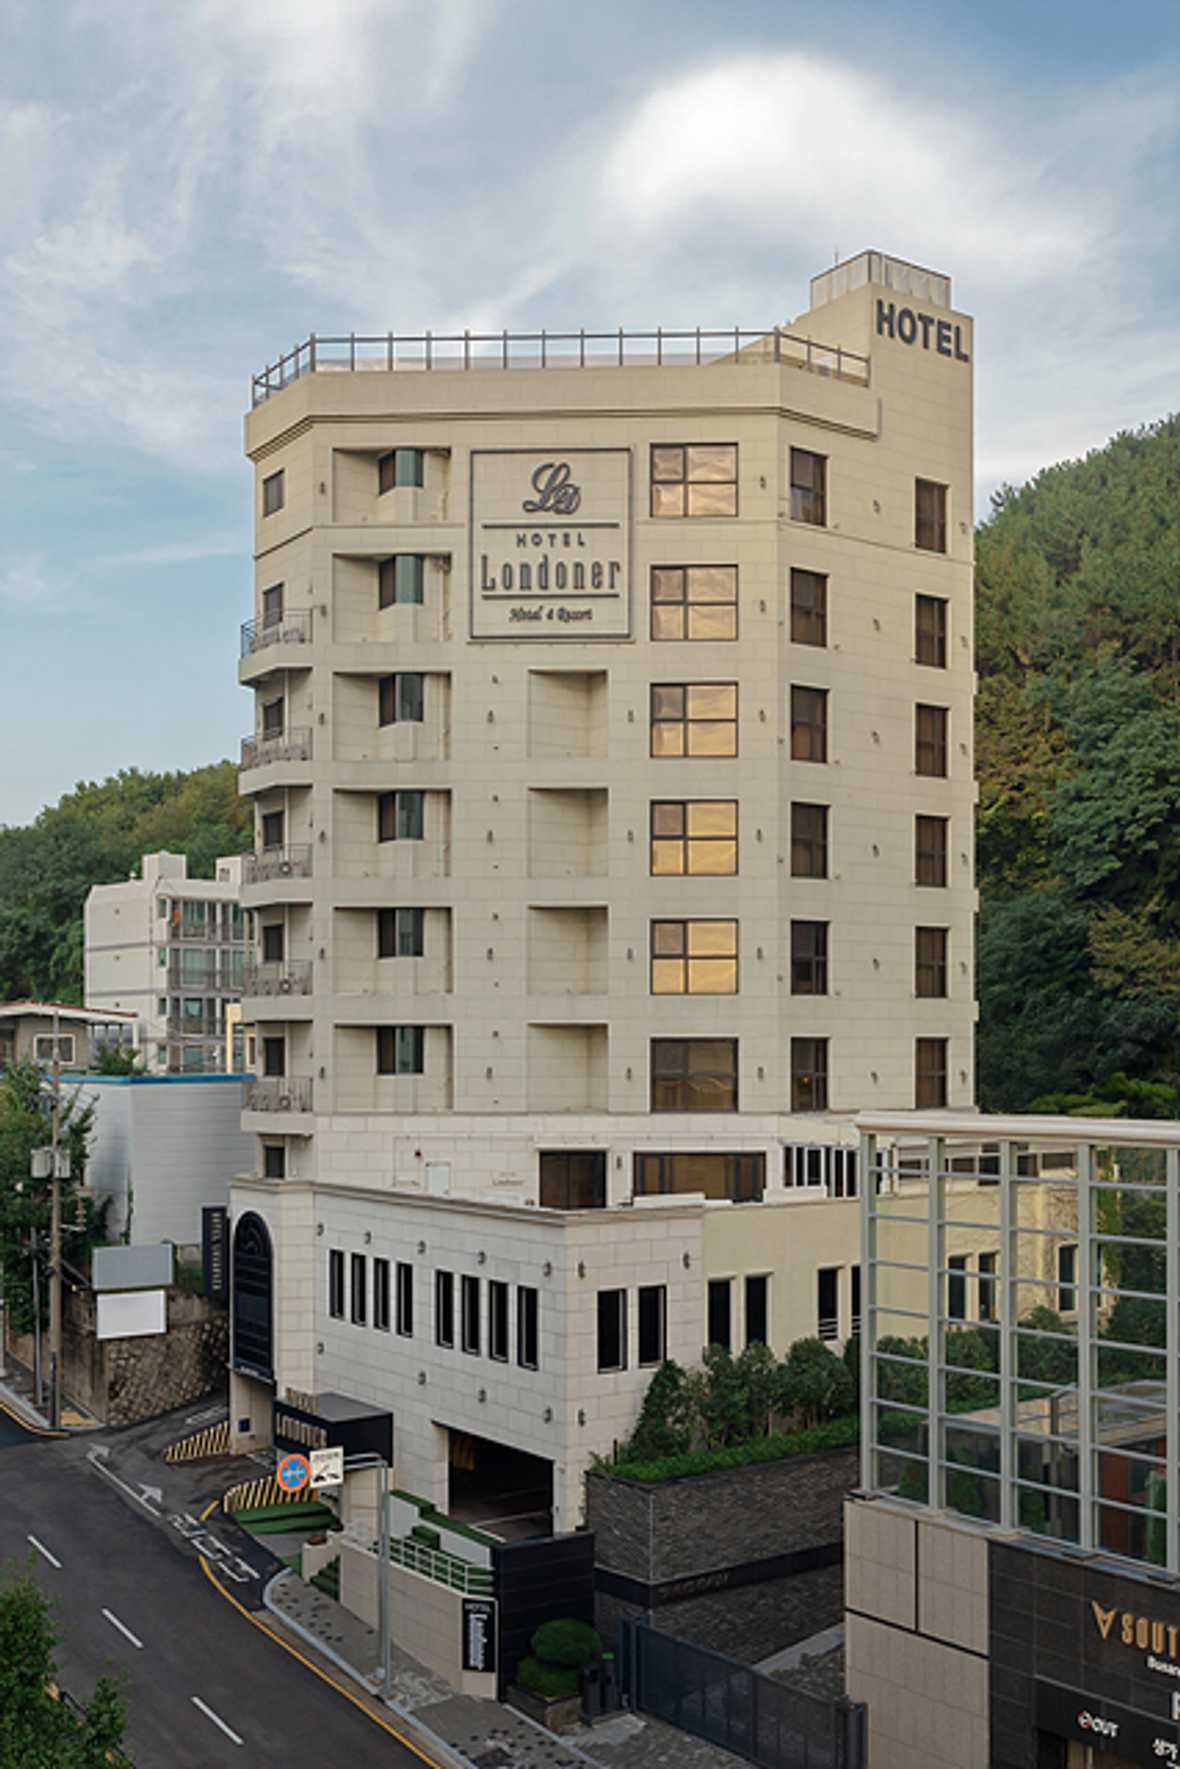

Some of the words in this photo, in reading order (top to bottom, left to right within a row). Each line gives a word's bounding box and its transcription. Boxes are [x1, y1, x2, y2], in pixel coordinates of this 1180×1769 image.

[876, 298, 969, 363] HOTEL
[516, 532, 585, 548] HOTEL
[481, 553, 621, 591] Londoner
